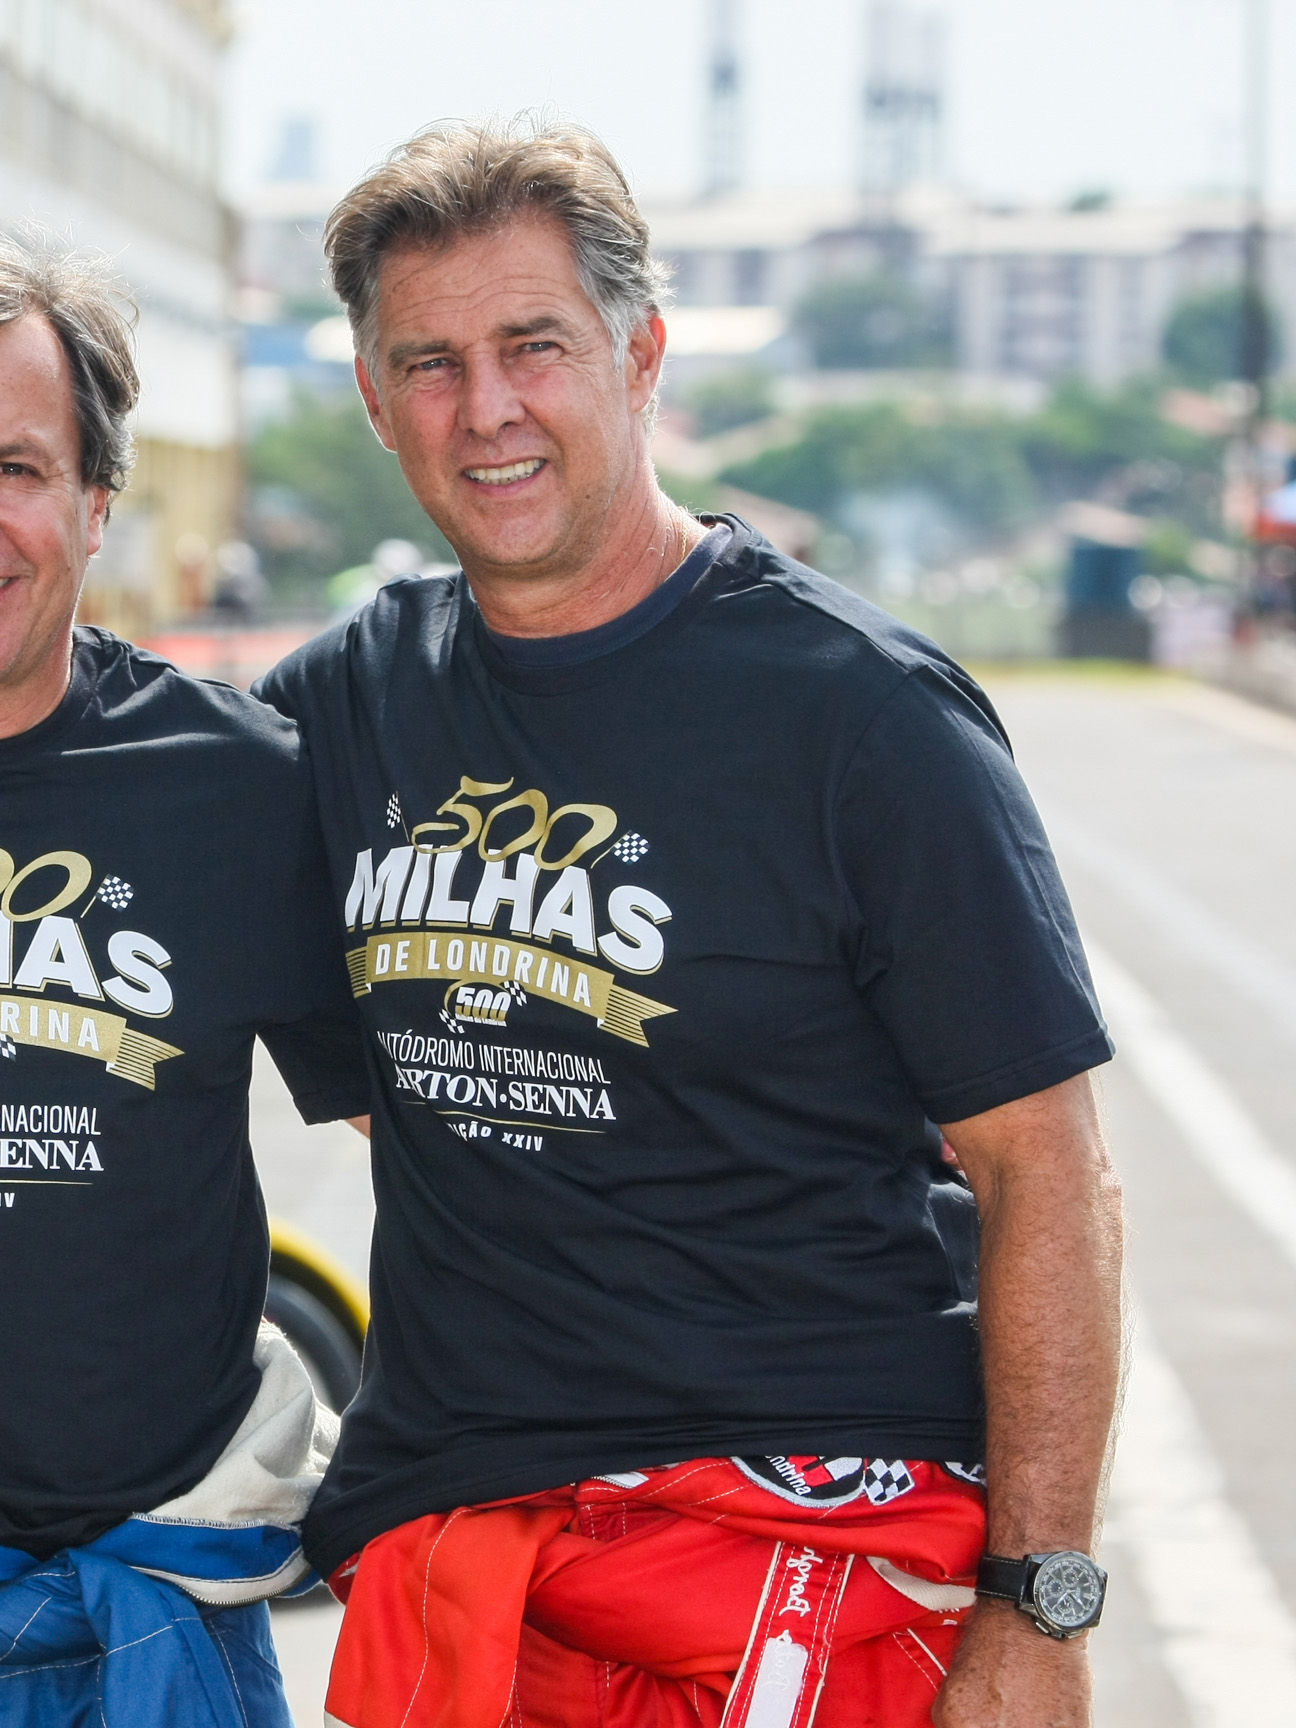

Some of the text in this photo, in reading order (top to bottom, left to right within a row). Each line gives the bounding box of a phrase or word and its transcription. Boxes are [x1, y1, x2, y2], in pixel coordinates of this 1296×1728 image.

[411, 775, 617, 870] 500
[344, 844, 673, 974] MILHAS
[375, 939, 591, 1008] DE LONDRINA
[455, 987, 511, 1021] 500
[479, 1044, 611, 1084] INTERNACIONAL
[501, 1132, 543, 1152] XXIV
